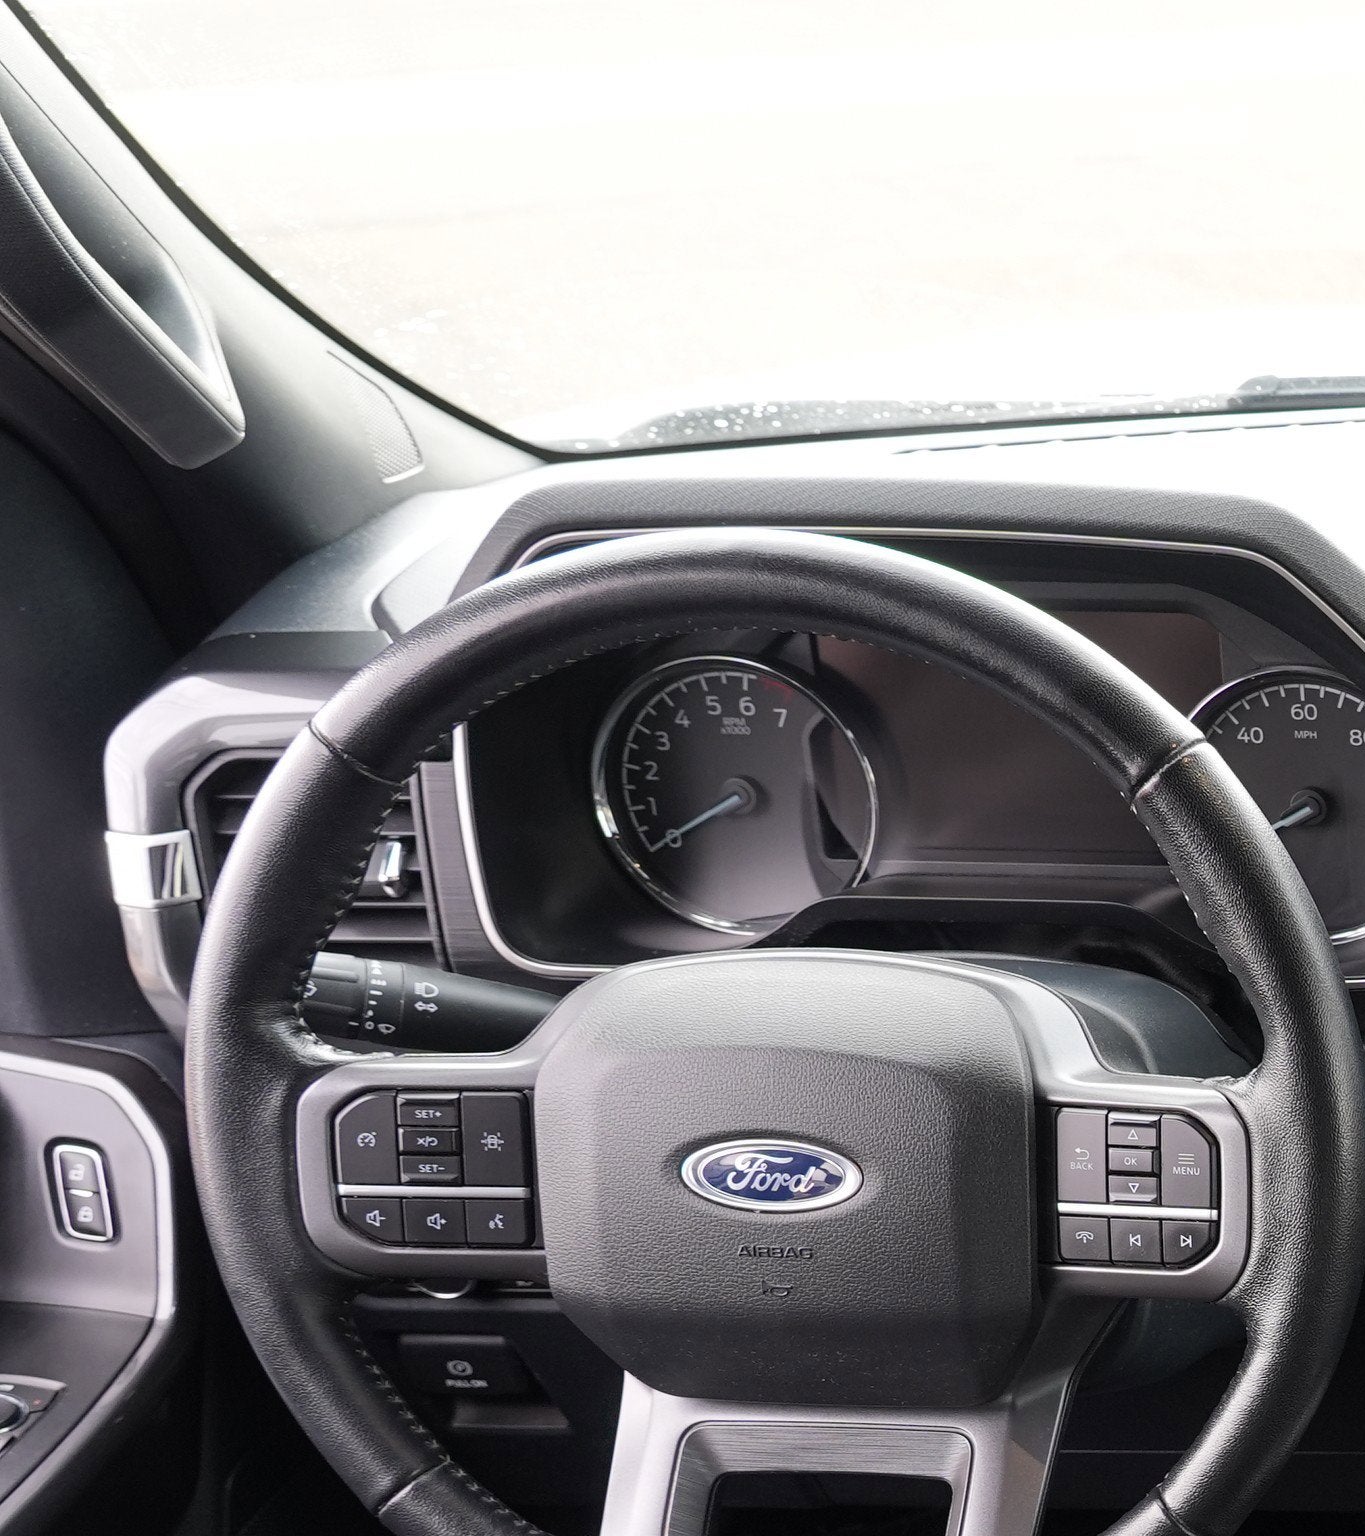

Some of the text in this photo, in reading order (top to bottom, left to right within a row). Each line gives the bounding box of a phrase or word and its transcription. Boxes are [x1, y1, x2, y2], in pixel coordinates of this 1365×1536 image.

[706, 695, 721, 715] 5
[738, 696, 756, 716] 6
[1290, 703, 1318, 721] 60
[674, 709, 691, 728] 4
[773, 708, 788, 728] 7
[656, 732, 671, 751] 3
[1236, 726, 1264, 744] 40
[1294, 730, 1318, 740] MPH
[645, 761, 660, 780] 2
[646, 797, 656, 816] 1
[1070, 1161, 1094, 1171] BACK
[1123, 1157, 1138, 1166] OK
[1172, 1166, 1200, 1176] MENU
[726, 1152, 816, 1193] Ford
[738, 1245, 814, 1260] AIRBAG
